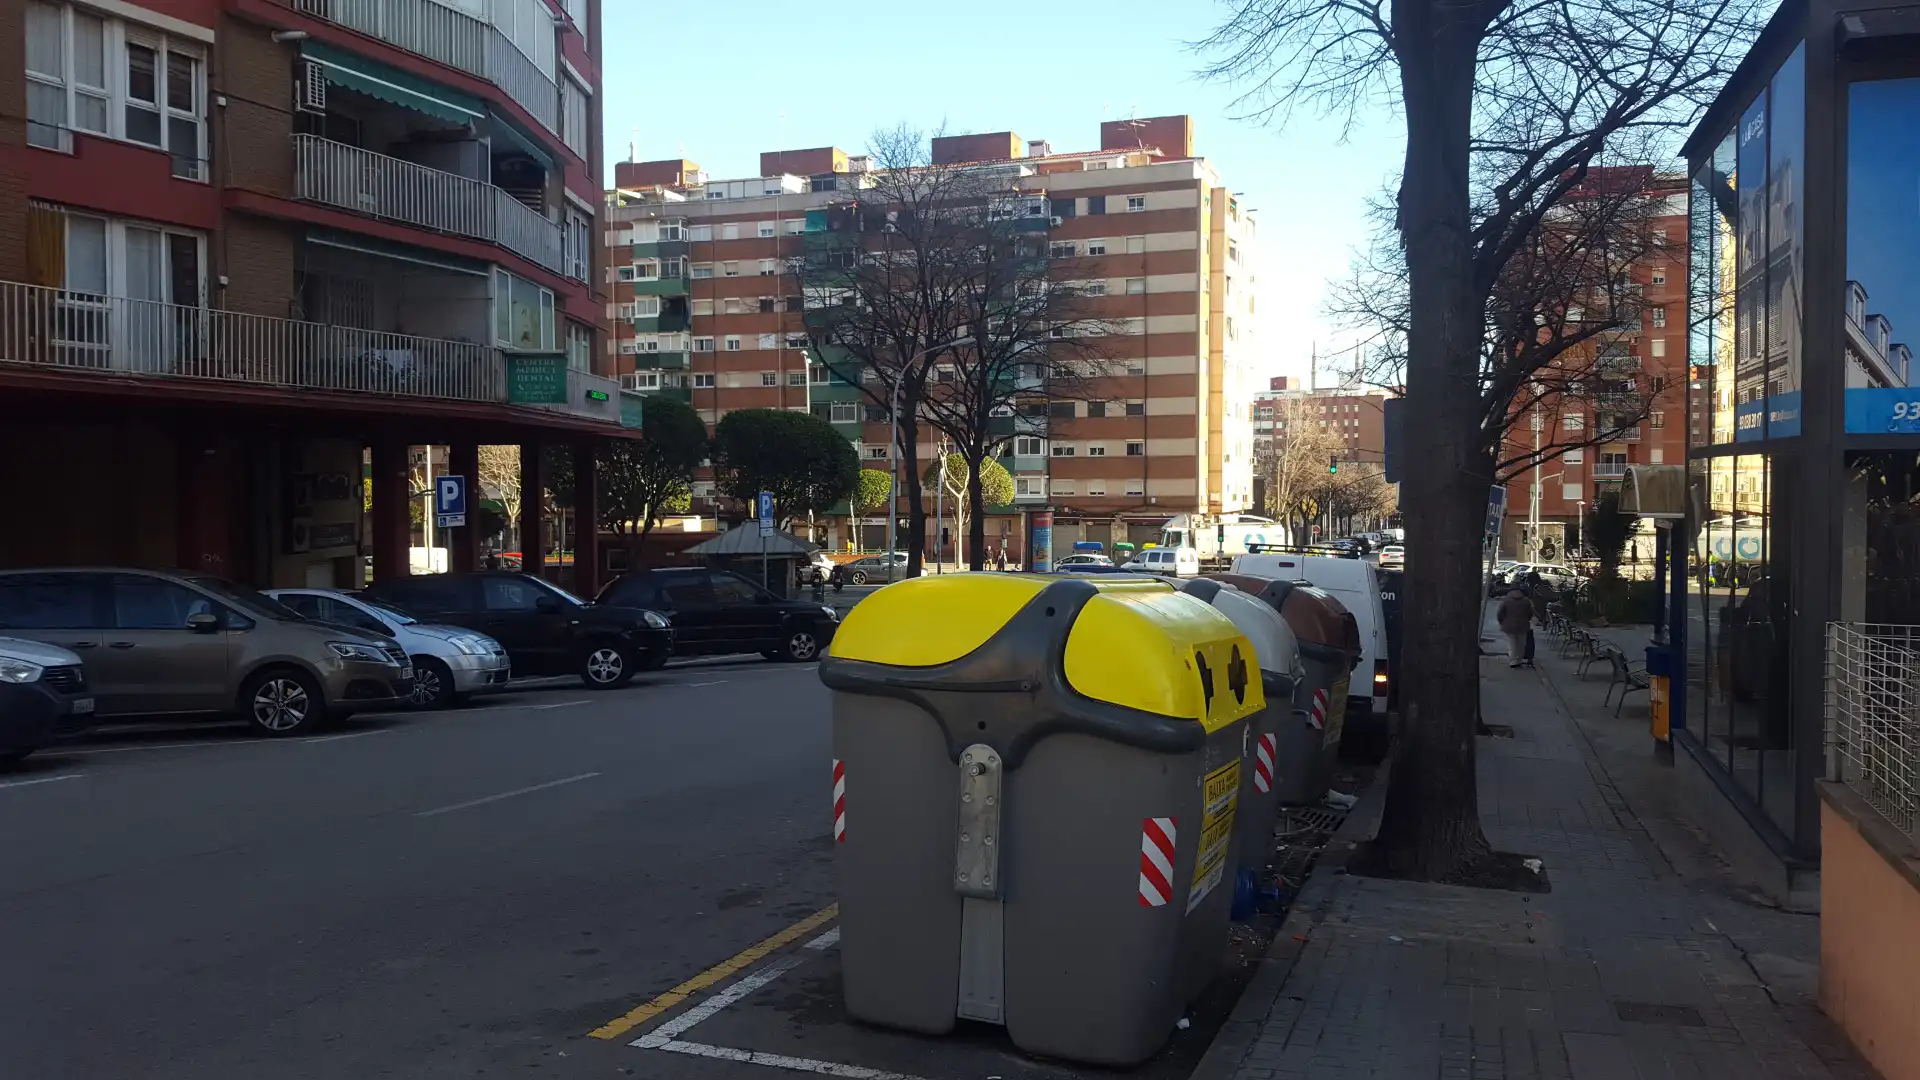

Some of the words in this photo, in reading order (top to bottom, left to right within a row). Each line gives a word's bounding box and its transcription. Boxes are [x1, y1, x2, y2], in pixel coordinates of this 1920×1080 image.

[517, 374, 555, 382] DENTAL
[441, 480, 459, 510] P
[762, 495, 771, 517] P
[1208, 778, 1226, 802] BAIXA
